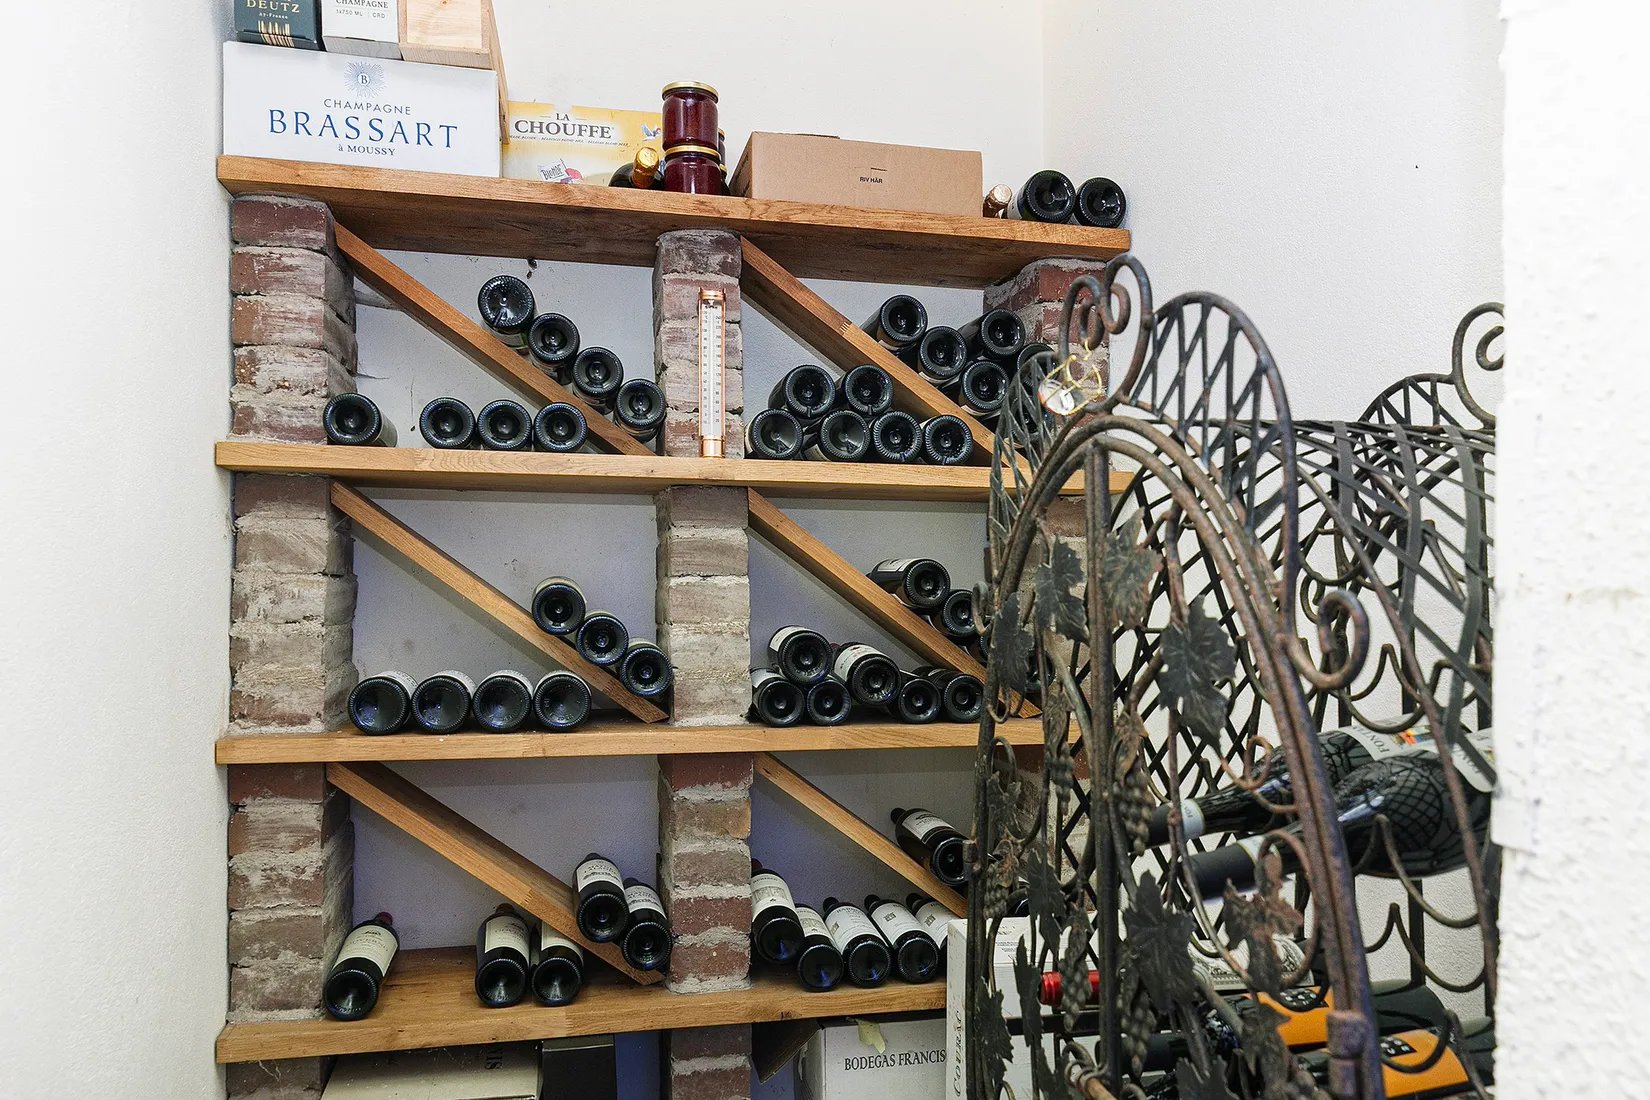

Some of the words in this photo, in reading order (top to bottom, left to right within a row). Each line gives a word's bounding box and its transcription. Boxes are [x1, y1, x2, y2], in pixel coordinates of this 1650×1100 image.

[246, 0, 300, 13] DEUTZ
[336, 0, 389, 9] CHAMPAGNE
[360, 74, 369, 85] B
[323, 98, 411, 115] CHAMPAGNE
[556, 113, 570, 122] LA
[268, 109, 458, 148] BRASSART
[514, 119, 612, 139] CHOUFFE
[347, 145, 396, 156] MOUSSY
[844, 1053, 896, 1071] BODEGAS
[898, 1049, 947, 1066] FRANCIS
